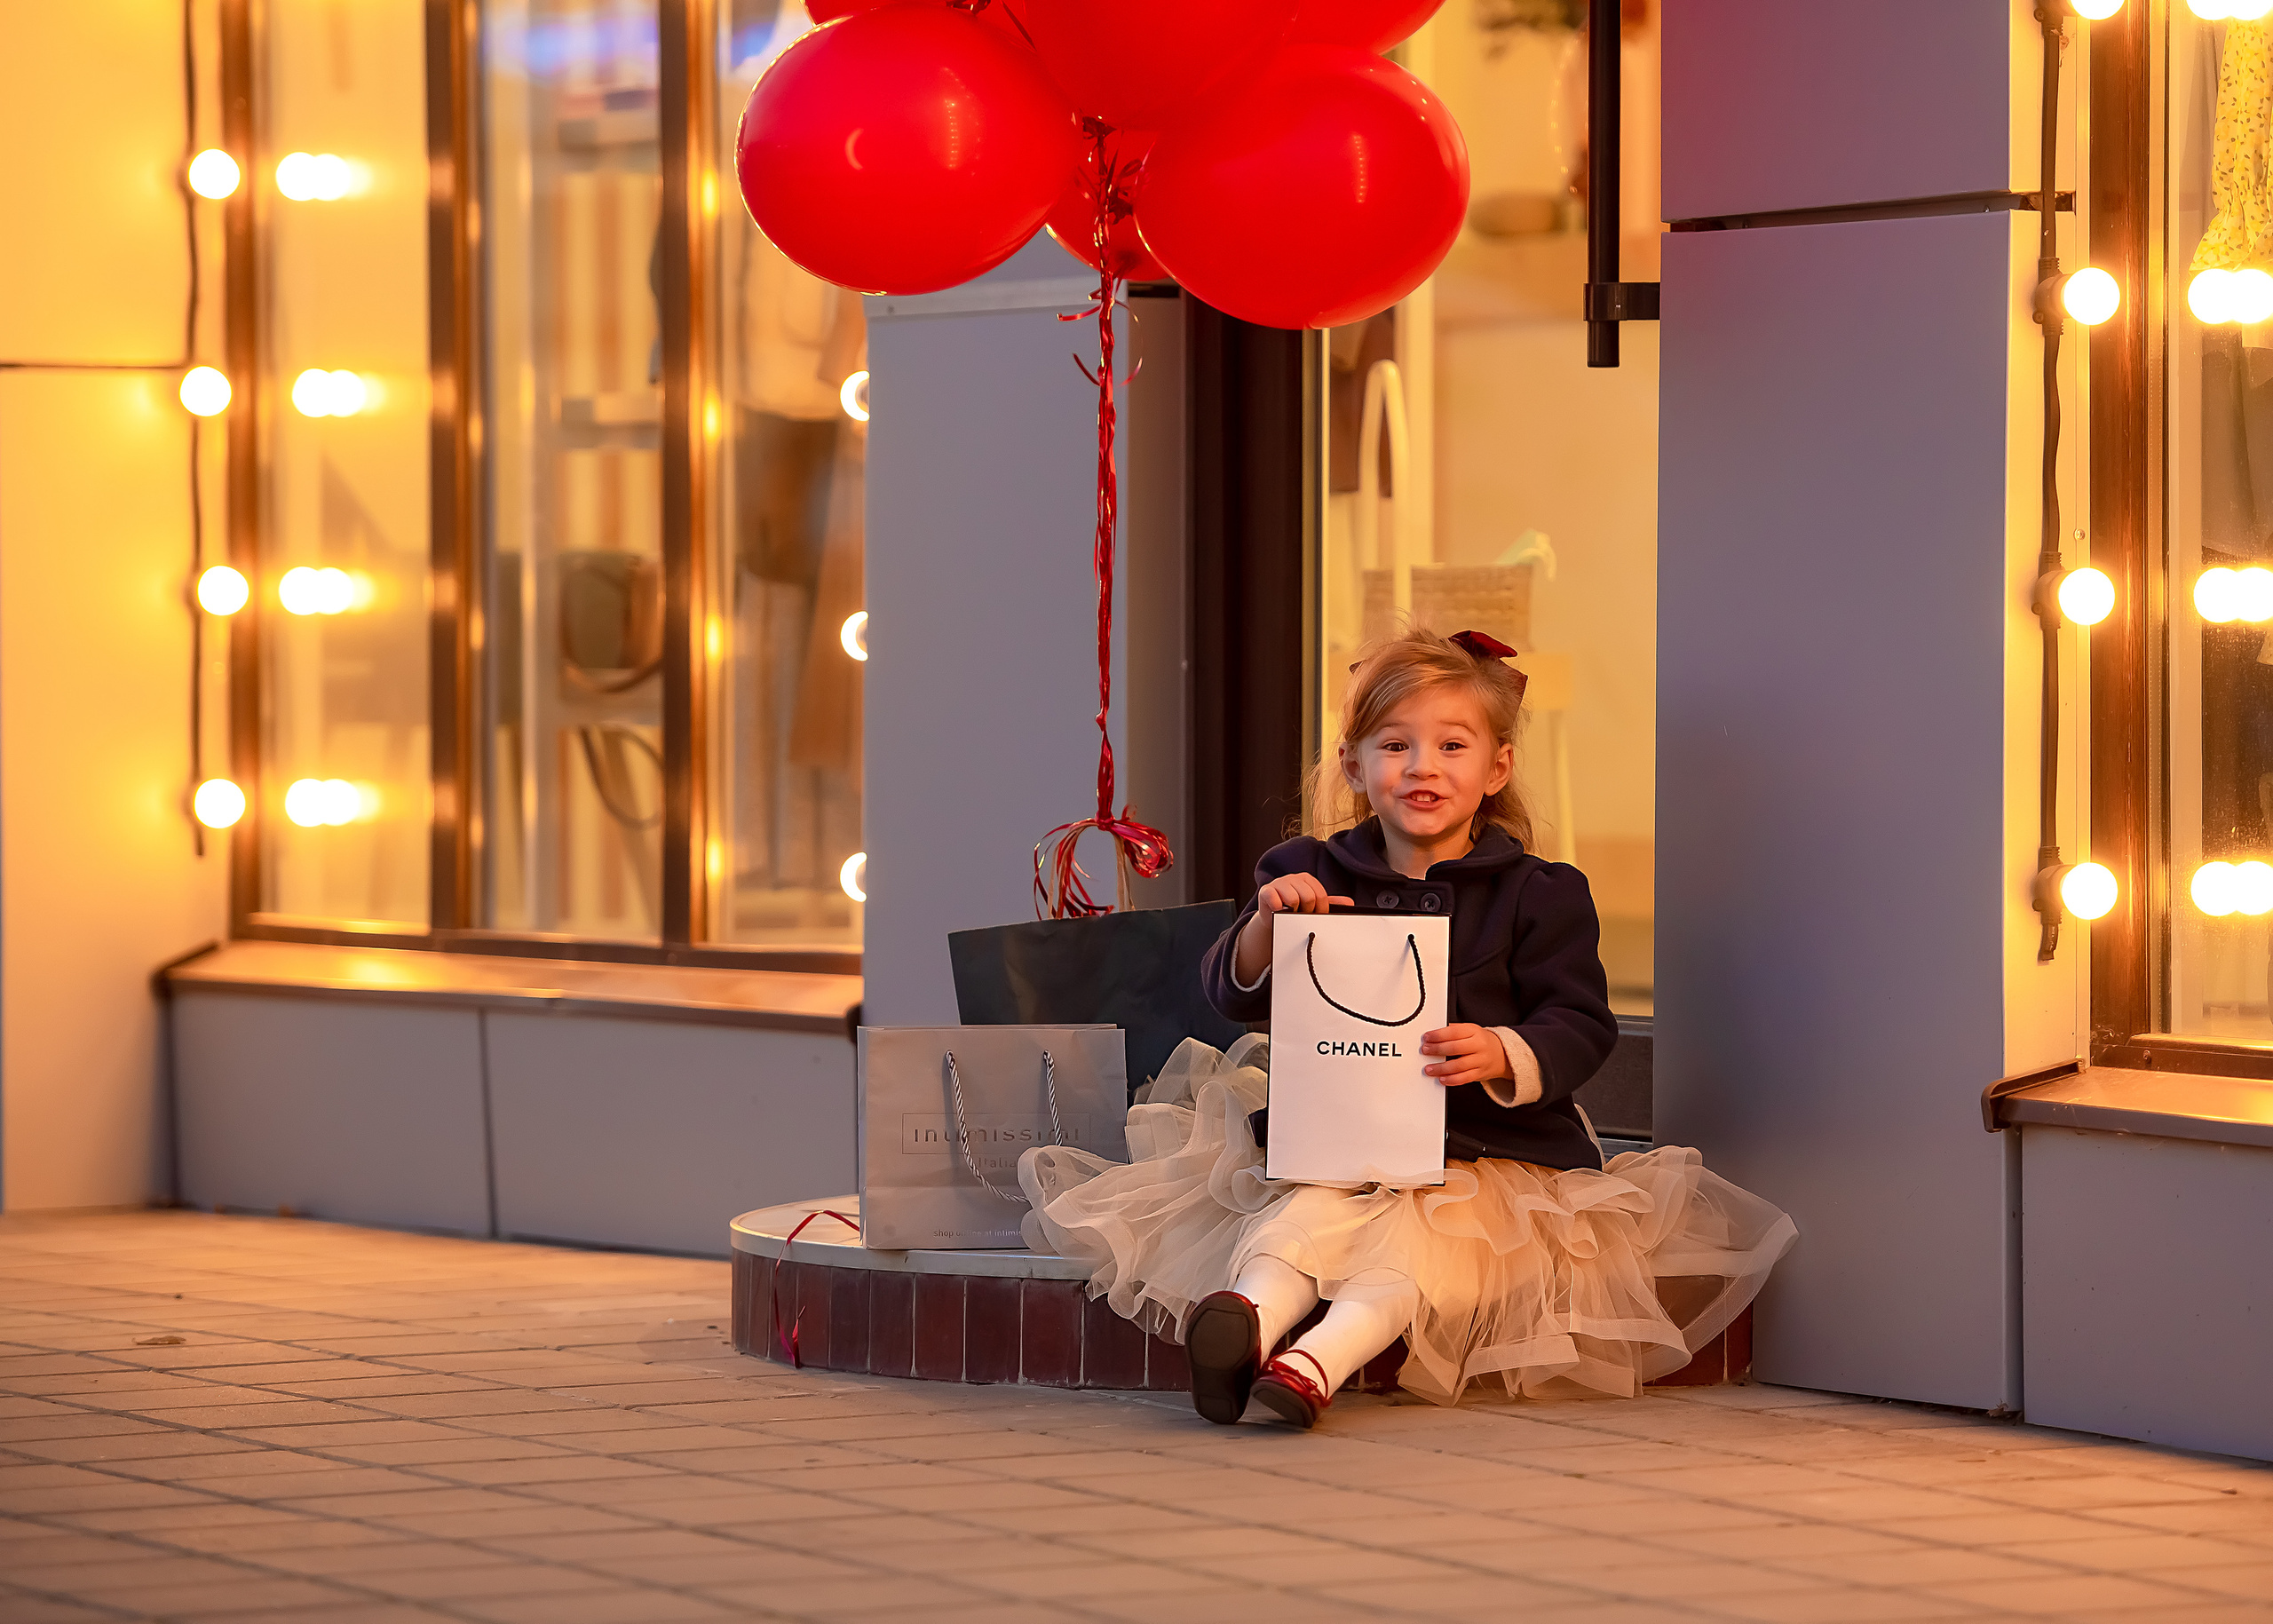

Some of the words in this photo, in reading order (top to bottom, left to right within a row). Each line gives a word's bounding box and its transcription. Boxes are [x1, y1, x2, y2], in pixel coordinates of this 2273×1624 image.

[1317, 1041, 1402, 1057] CHANEL
[978, 1157, 1018, 1168] Italia
[933, 1229, 954, 1238] shop
